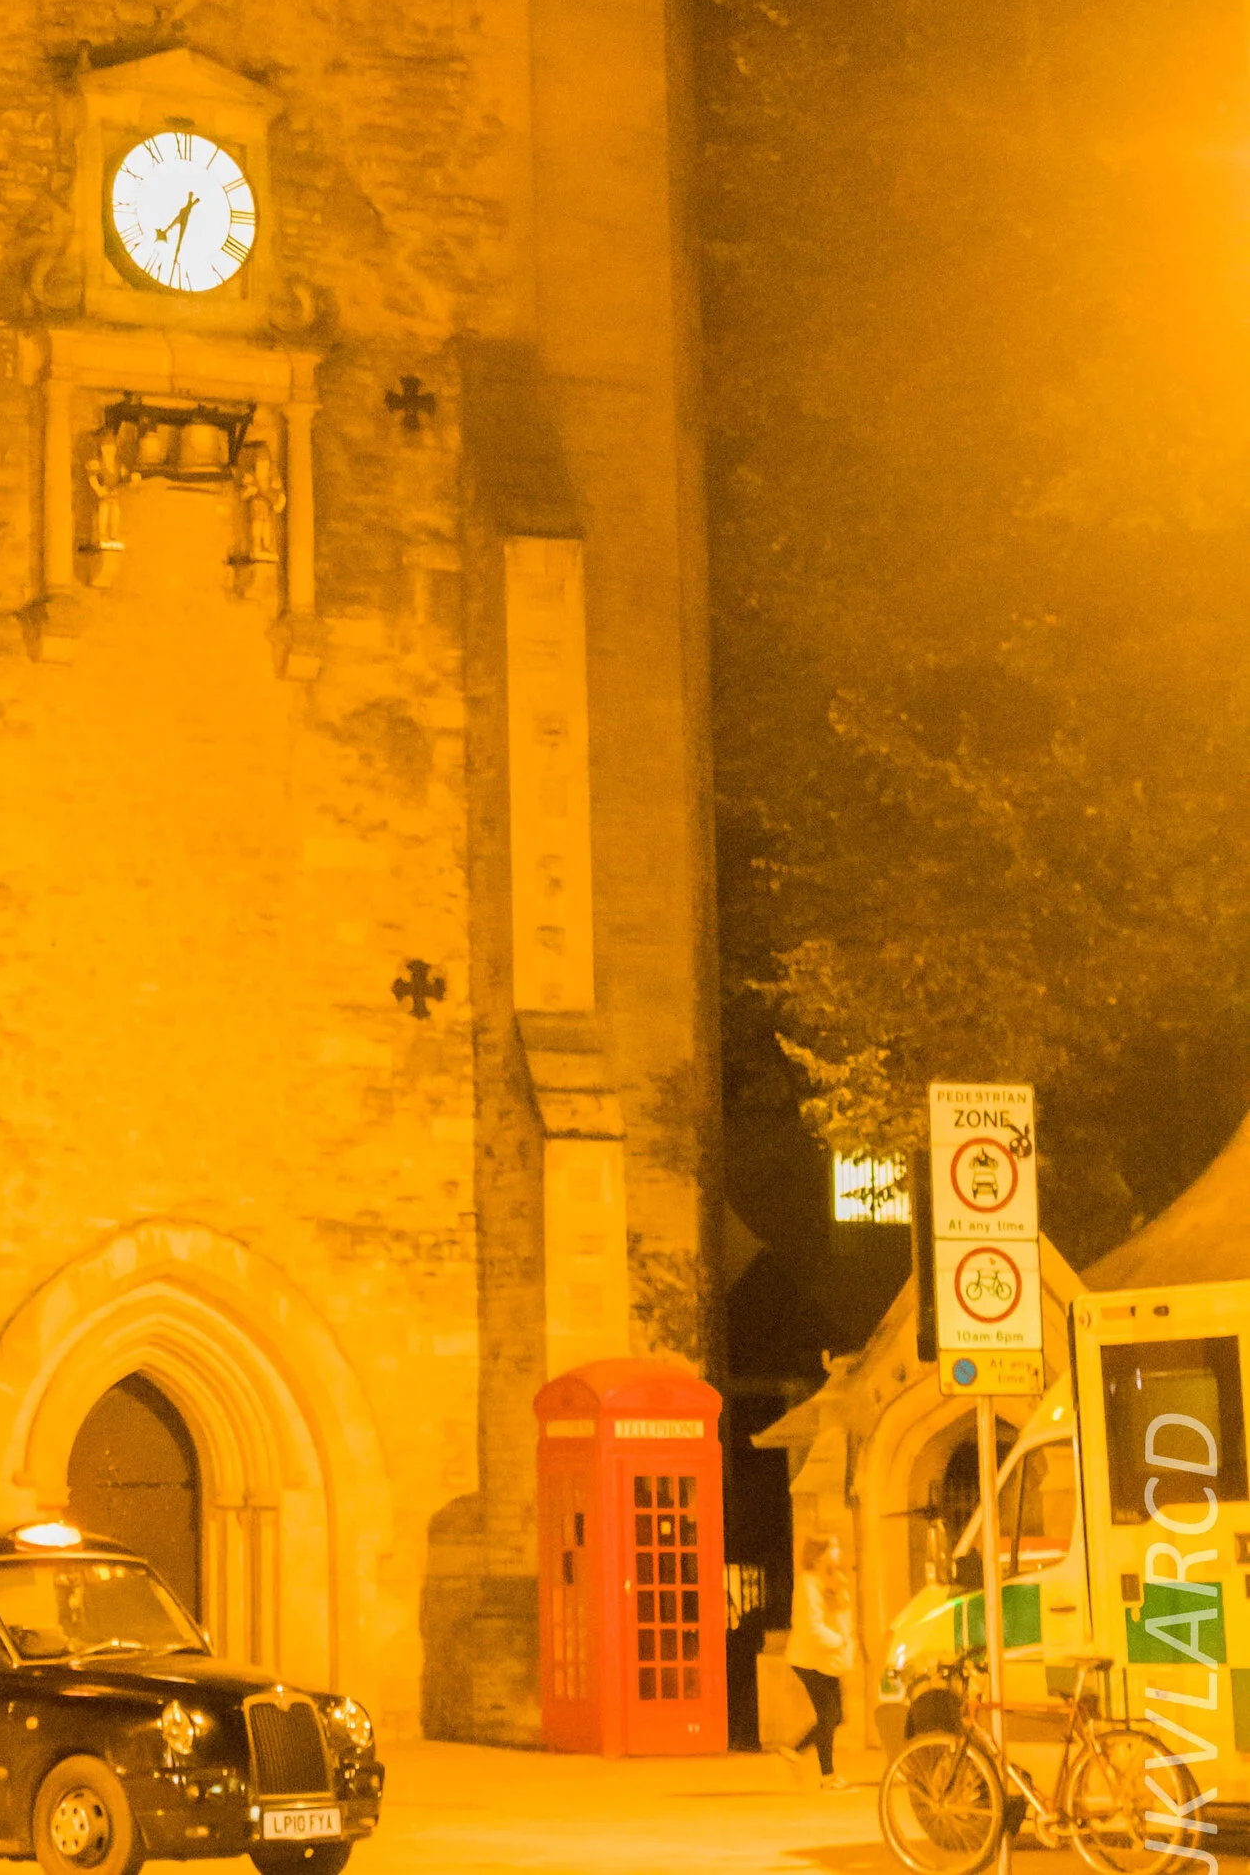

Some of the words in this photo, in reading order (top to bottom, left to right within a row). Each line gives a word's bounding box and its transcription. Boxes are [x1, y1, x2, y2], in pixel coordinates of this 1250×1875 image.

[937, 1090, 1027, 1104] PEDESTRIAN
[953, 1109, 1011, 1129] ZONE
[948, 1219, 962, 1231] At
[969, 1222, 990, 1234] any
[997, 1220, 1024, 1231] time
